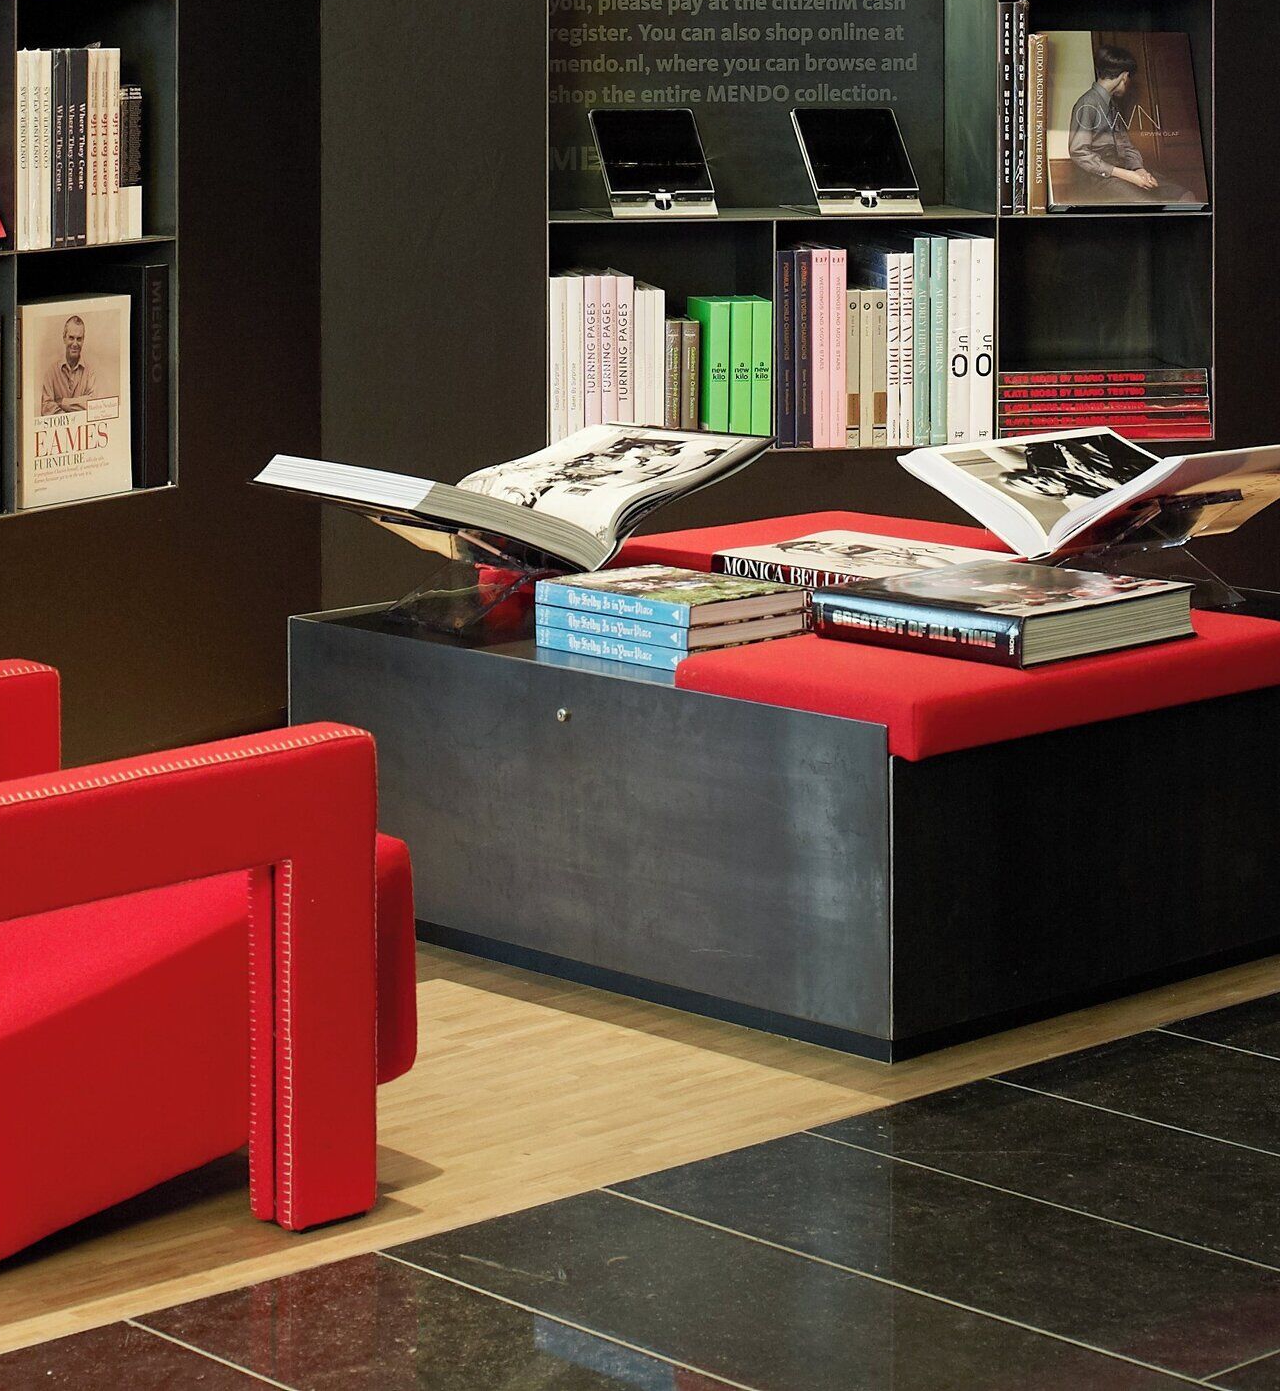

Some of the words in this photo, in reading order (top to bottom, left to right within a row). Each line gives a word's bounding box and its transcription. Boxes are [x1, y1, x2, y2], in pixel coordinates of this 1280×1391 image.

[550, 23, 632, 47] register.
[638, 24, 675, 41] You
[681, 26, 715, 41] can
[720, 23, 760, 41] also
[765, 23, 813, 46] shop
[819, 23, 879, 41] online
[884, 26, 904, 41] at
[550, 54, 650, 77] mendo.nl,
[656, 55, 718, 73] where
[723, 59, 760, 77] you
[765, 58, 799, 72] can
[805, 54, 875, 72] browse
[880, 54, 917, 72] and
[550, 85, 597, 108] shop
[602, 86, 635, 103] the
[640, 86, 701, 103] entire
[706, 85, 789, 103] MENDO
[794, 84, 897, 102] collection.
[78, 103, 86, 133] Where
[1076, 104, 1160, 130] OWN
[77, 136, 86, 158] They
[618, 303, 628, 342] PAGES
[618, 346, 628, 401] TURNING
[43, 415, 70, 429] STORY
[34, 423, 109, 458] EAMES
[34, 452, 86, 471] FURNITURE
[723, 557, 784, 583] MONICA
[832, 610, 906, 634] GREATEST
[908, 621, 926, 637] OF
[929, 625, 957, 642] ALL
[960, 627, 997, 648] TIME
